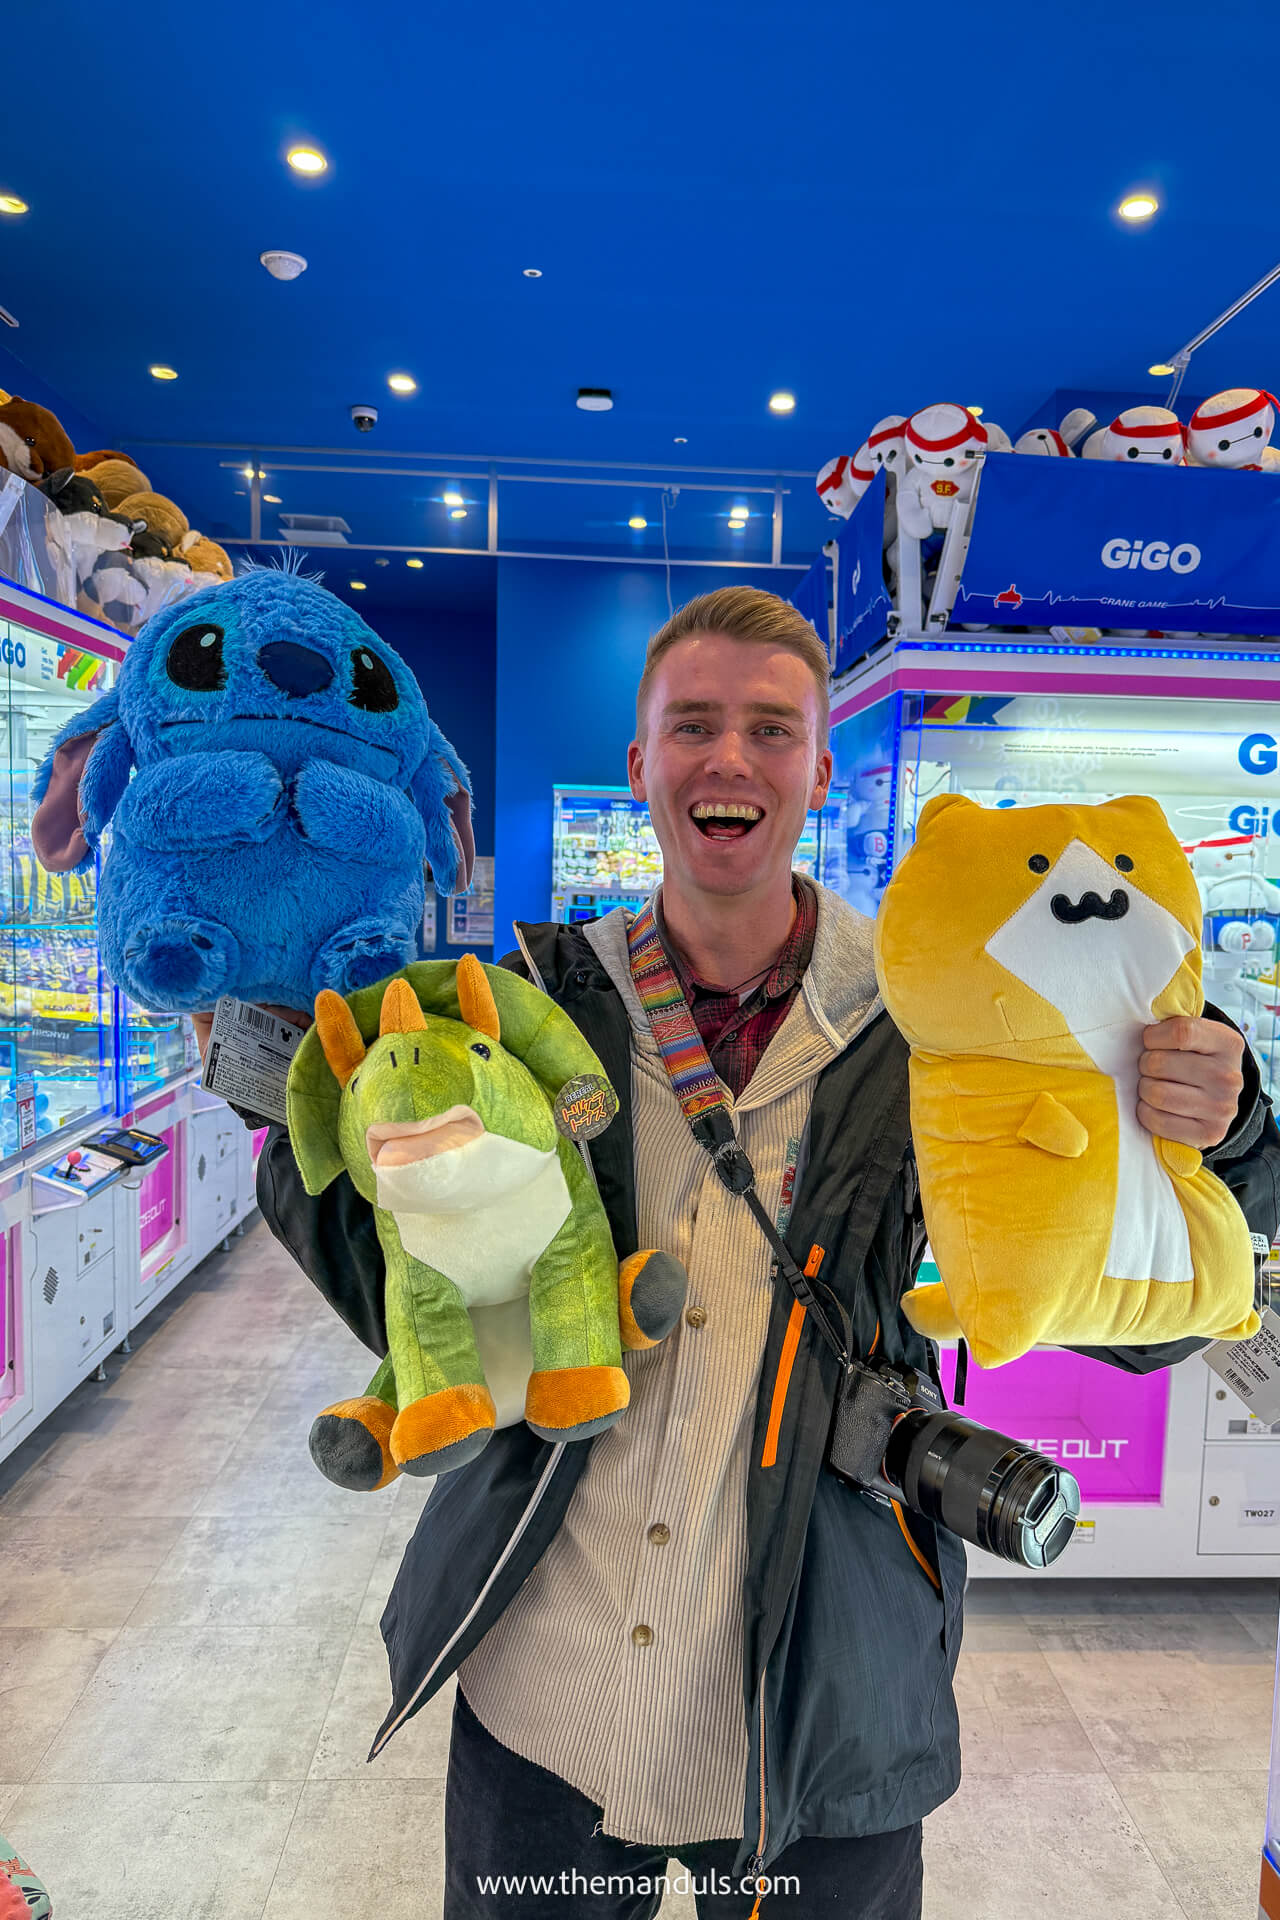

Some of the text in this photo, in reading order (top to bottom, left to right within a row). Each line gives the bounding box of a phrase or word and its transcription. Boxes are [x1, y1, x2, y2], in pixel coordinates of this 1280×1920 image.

[1101, 538, 1201, 574] GiGO
[1100, 597, 1136, 608] CRANE
[1229, 805, 1280, 837] Gi
[920, 1385, 937, 1400] SONY
